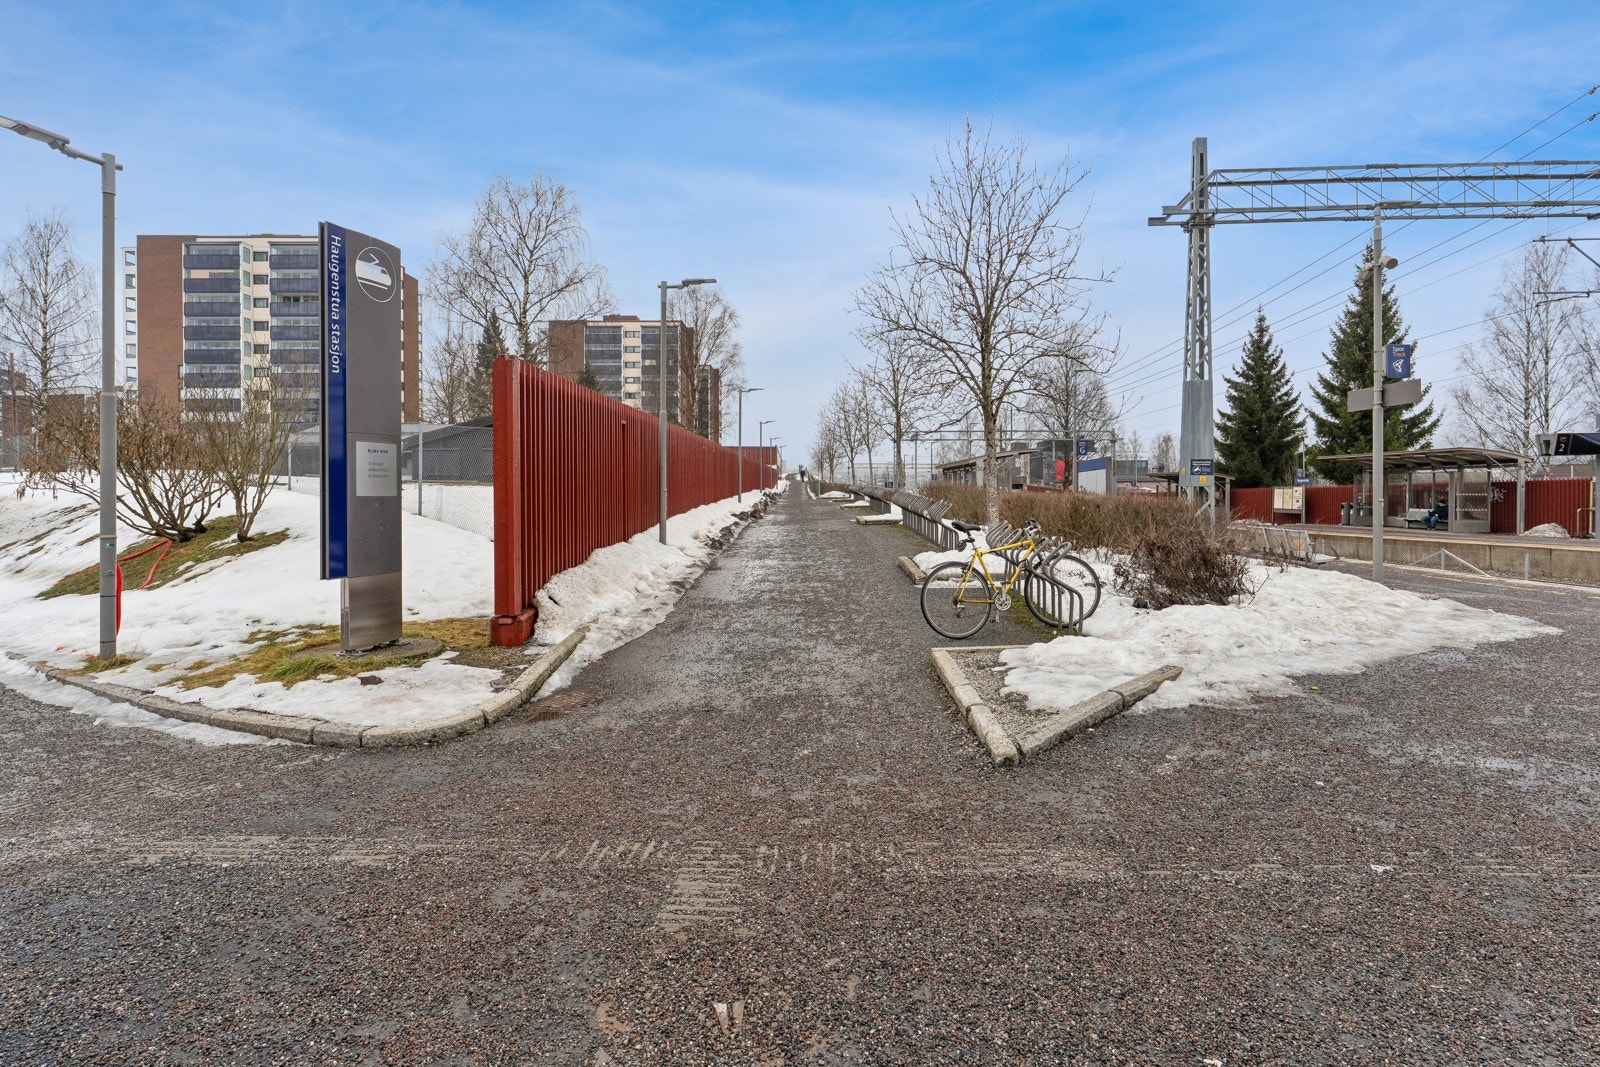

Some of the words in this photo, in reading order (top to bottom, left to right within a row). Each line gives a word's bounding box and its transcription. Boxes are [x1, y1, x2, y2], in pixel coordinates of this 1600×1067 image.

[328, 235, 341, 320] Haugenstua
[328, 323, 342, 373] stasjon
[1558, 444, 1565, 452] 2
